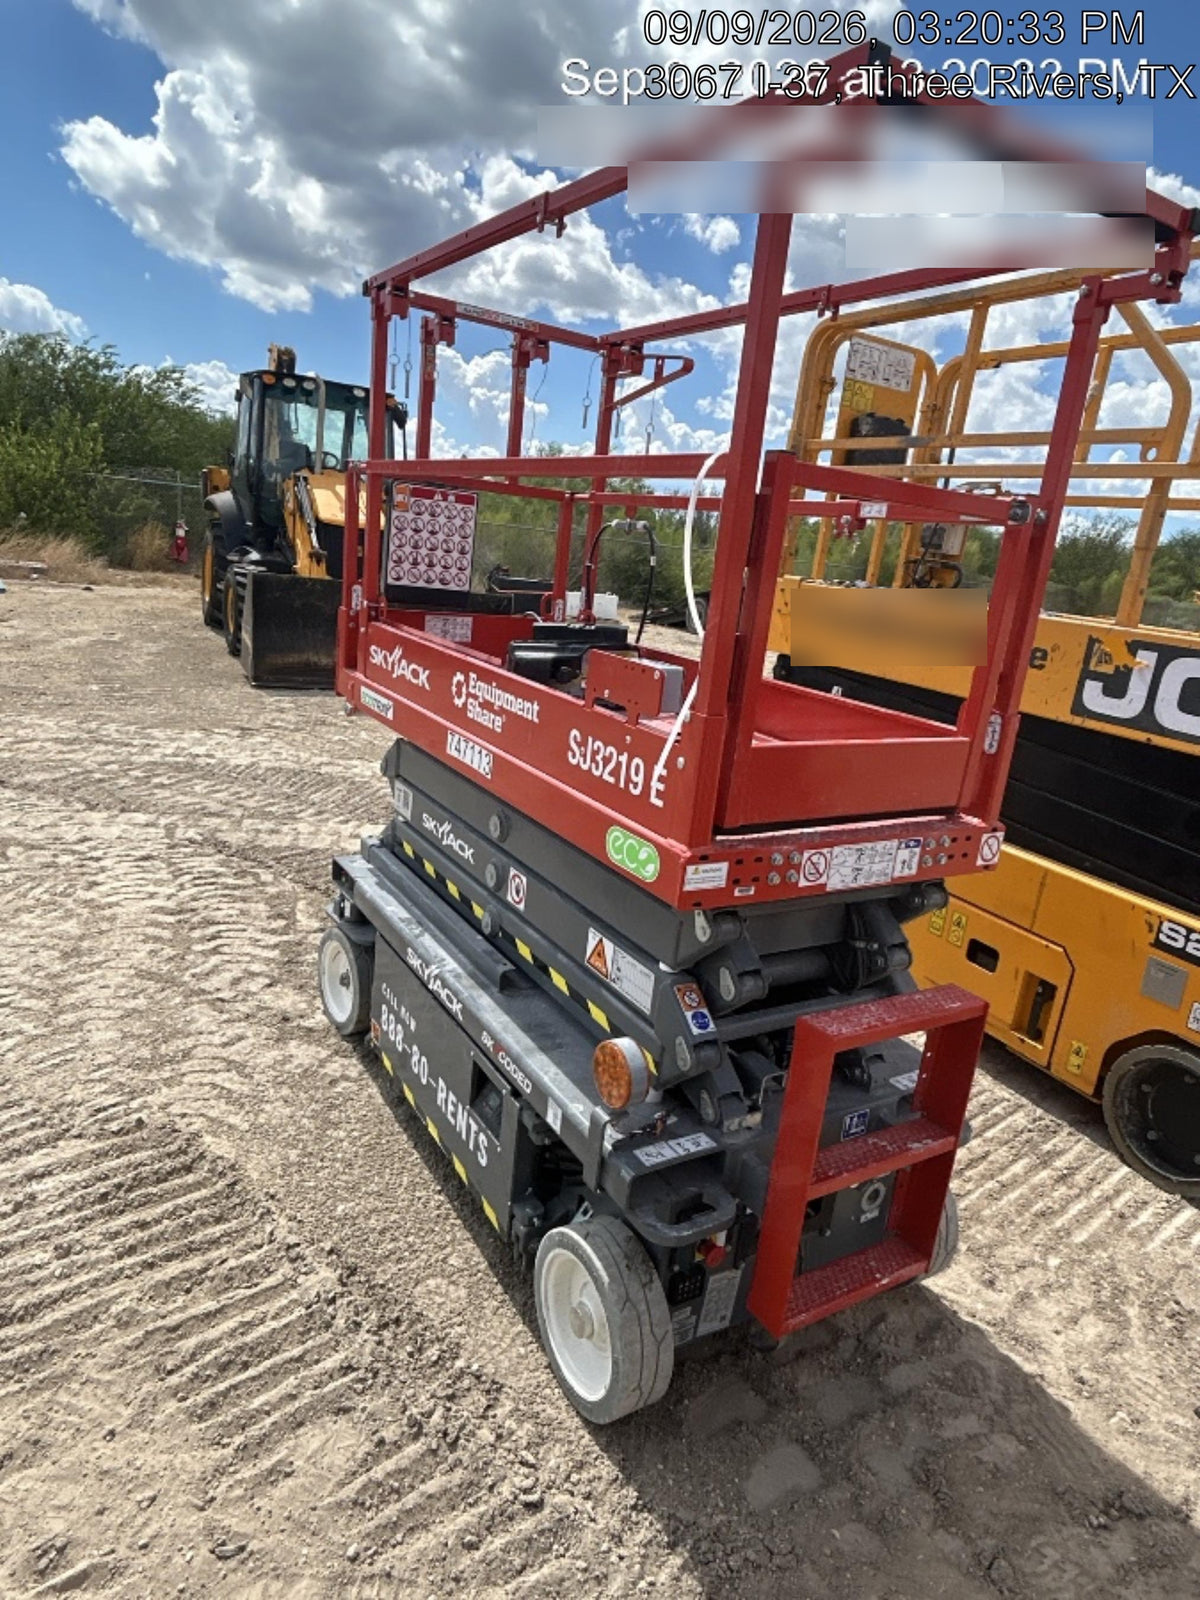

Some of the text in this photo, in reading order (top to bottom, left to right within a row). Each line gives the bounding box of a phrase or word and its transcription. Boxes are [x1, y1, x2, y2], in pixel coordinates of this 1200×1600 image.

[368, 644, 431, 691] SKYJACK
[468, 672, 539, 724] Equipment
[568, 728, 668, 808] SJ3219 E
[422, 812, 475, 865] SKYJACK
[406, 947, 463, 1021] SKYJACK
[381, 1003, 488, 1168] 888-80-RENTS
